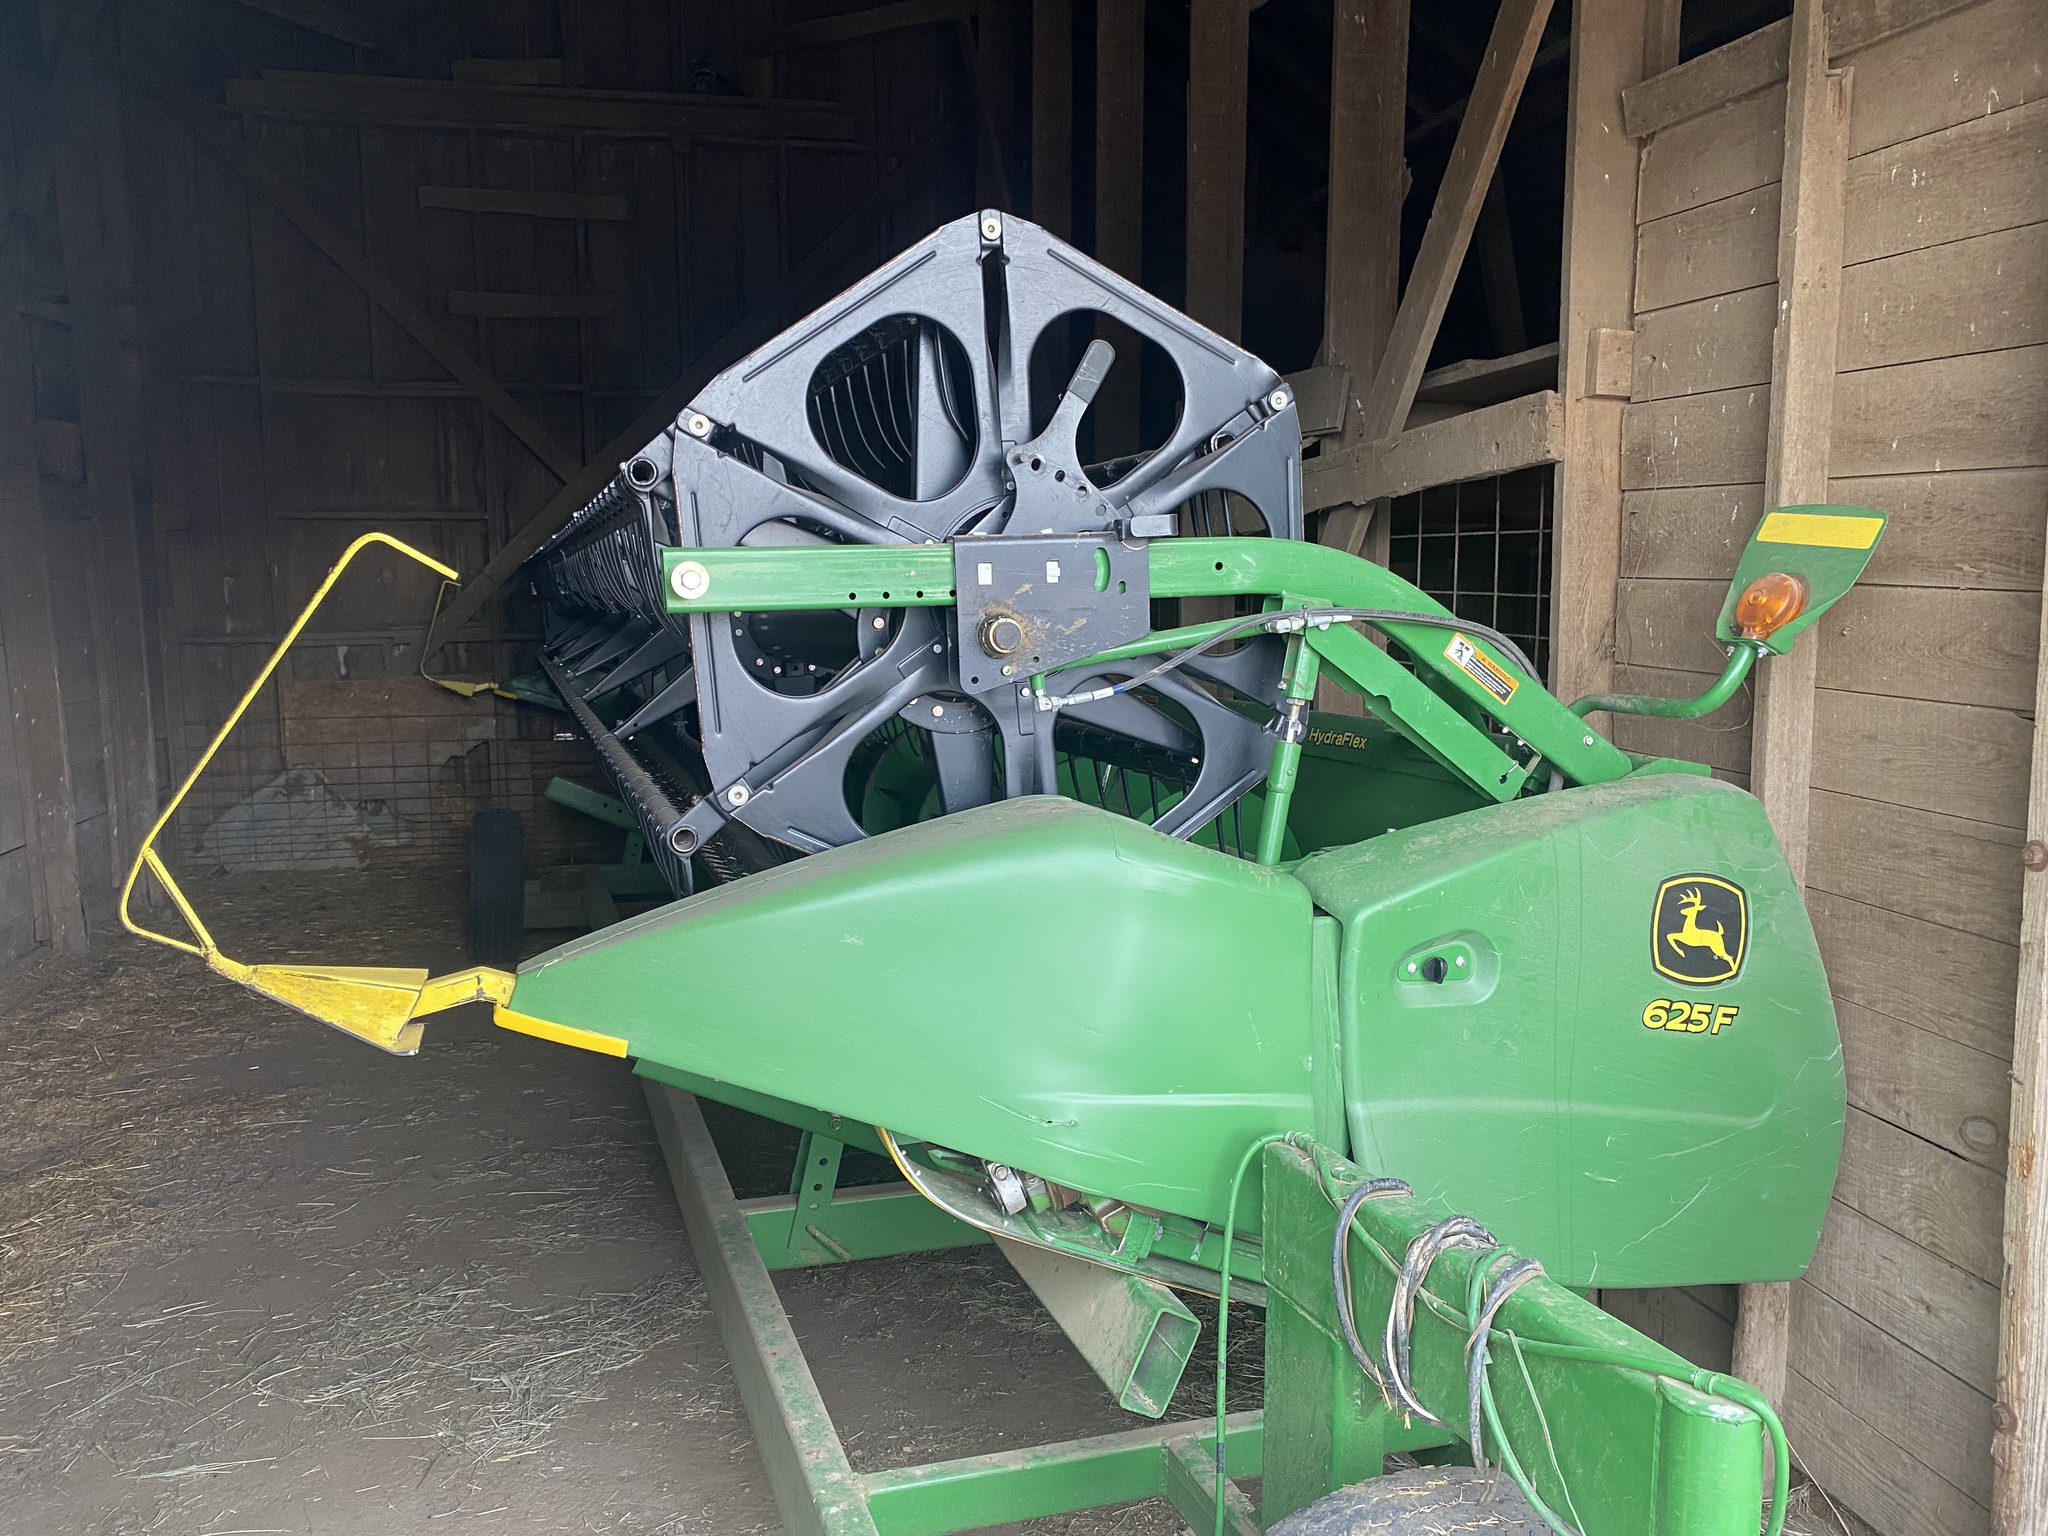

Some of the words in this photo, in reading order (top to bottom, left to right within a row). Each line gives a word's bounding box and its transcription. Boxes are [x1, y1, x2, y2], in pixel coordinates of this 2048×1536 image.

[1487, 661, 1512, 682] WARNING
[1309, 728, 1368, 749] HydraFlex
[1642, 998, 1740, 1035] 625F
